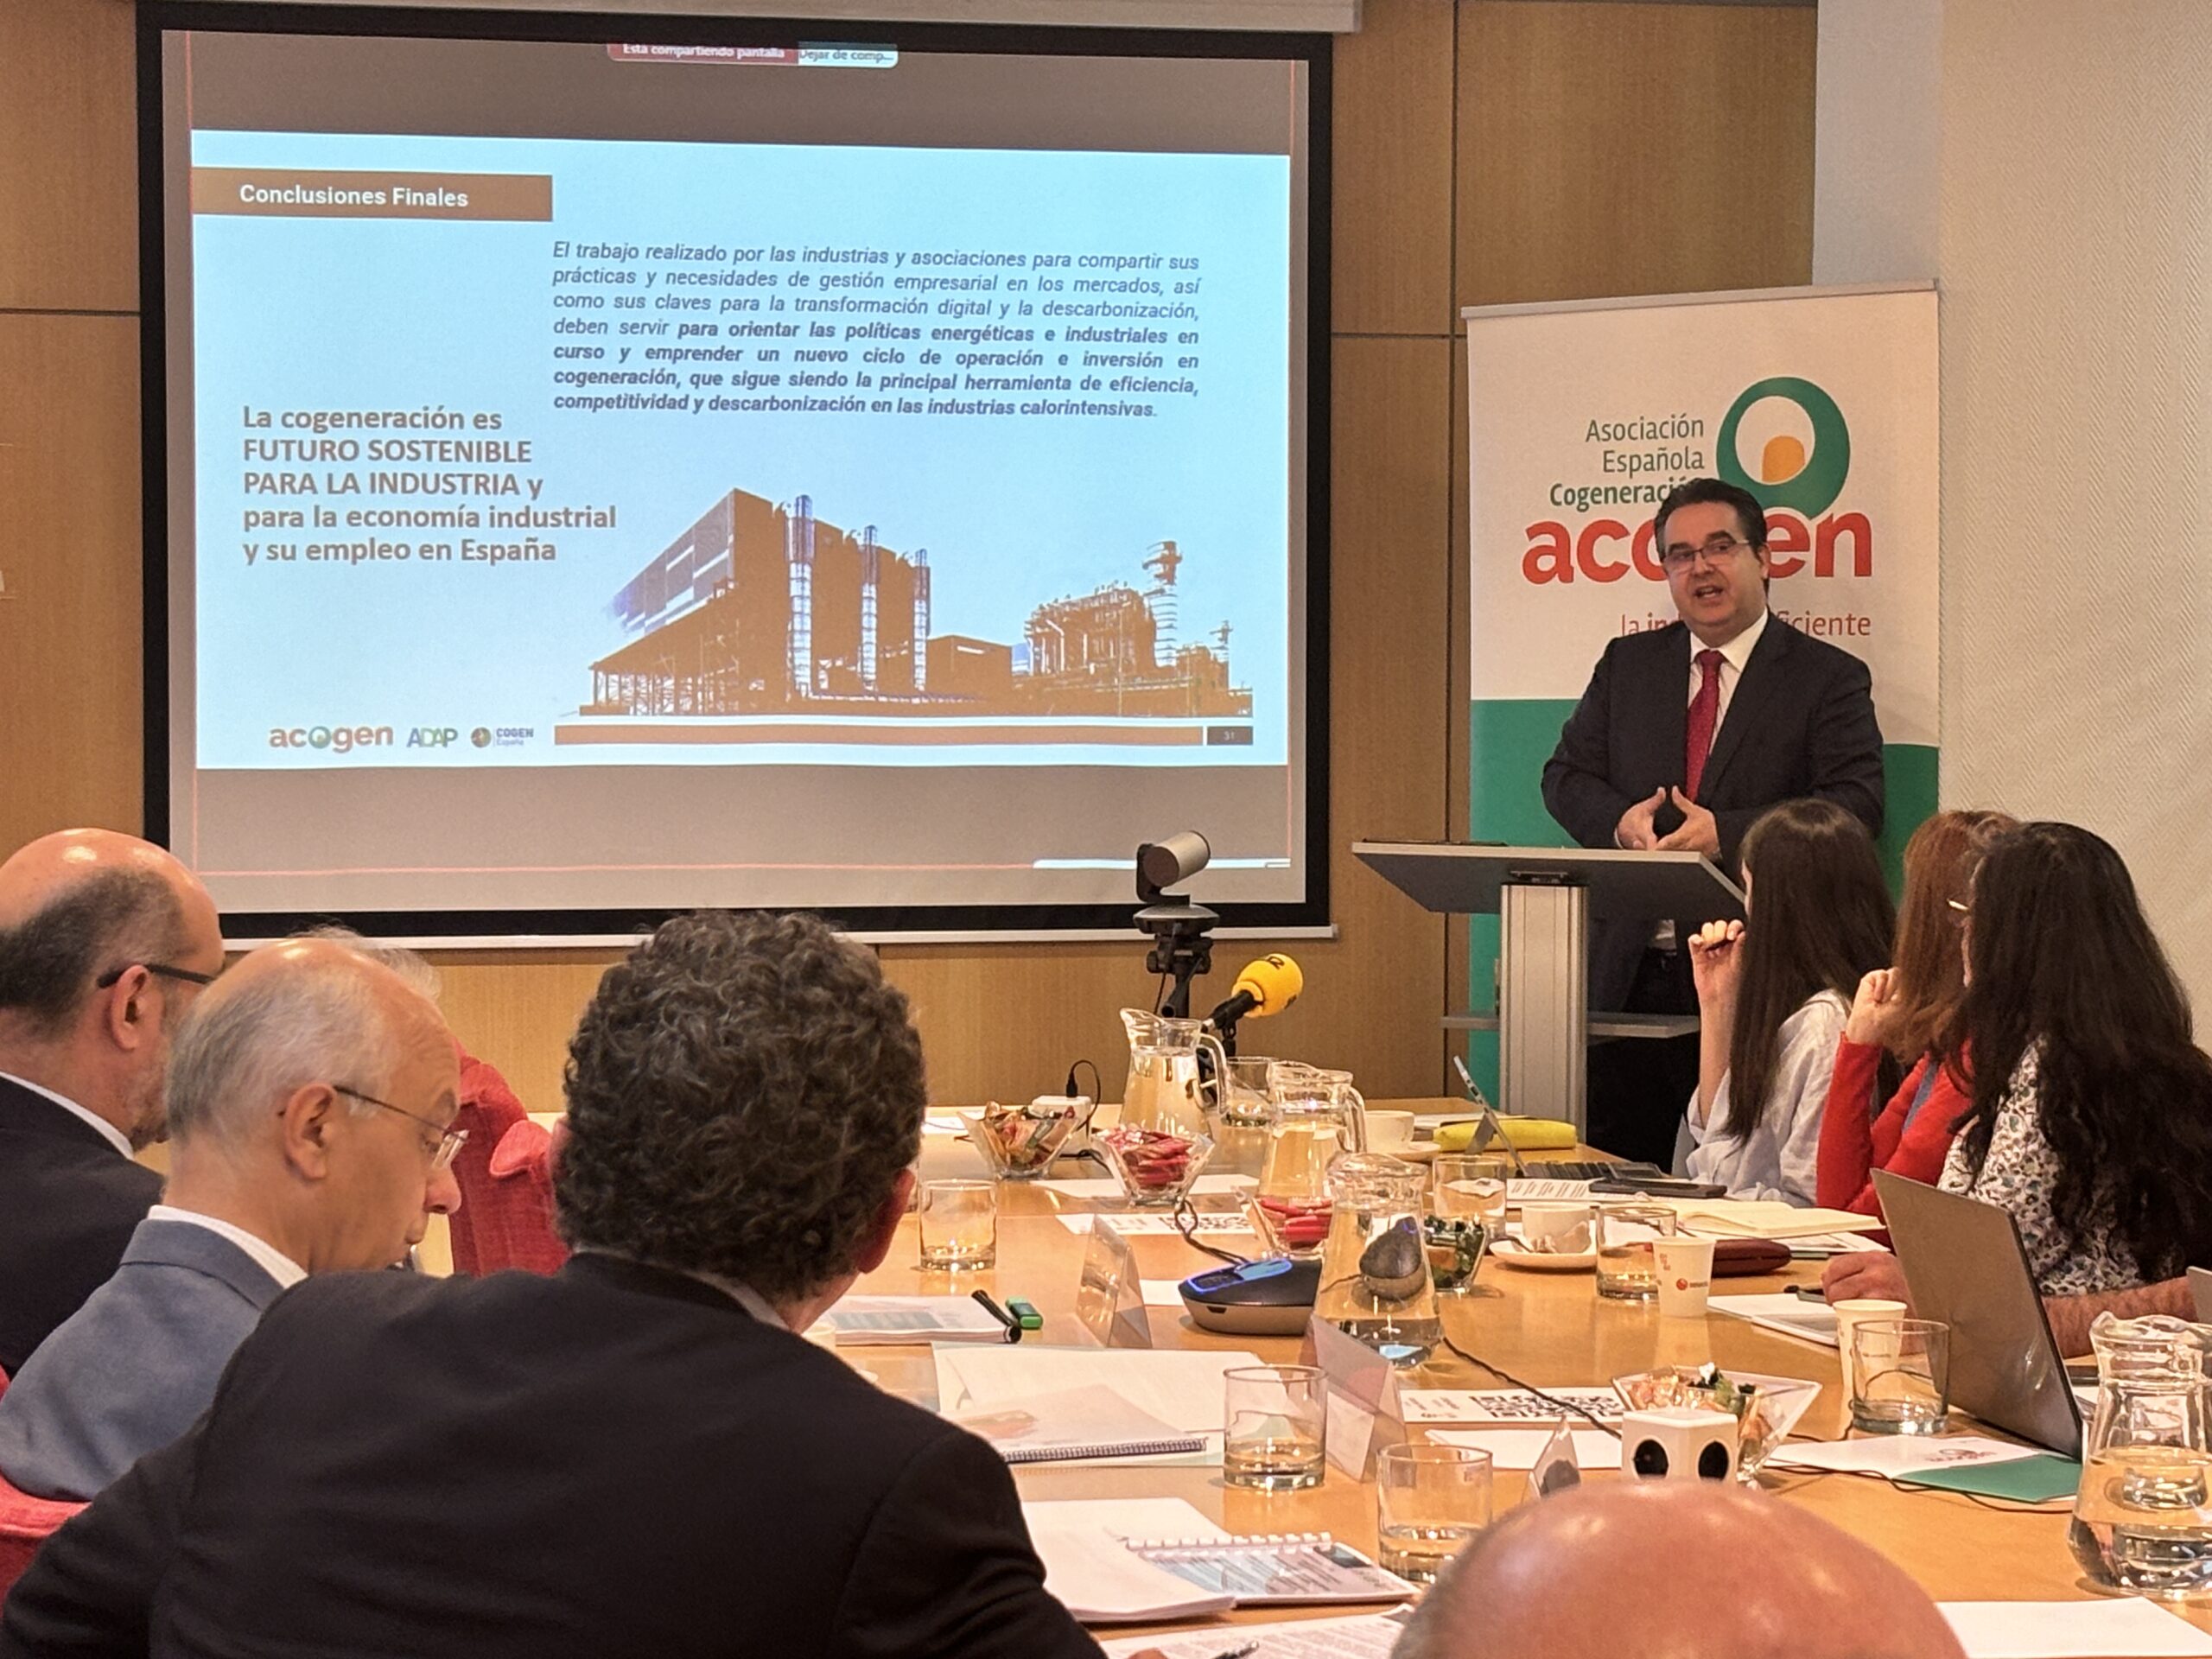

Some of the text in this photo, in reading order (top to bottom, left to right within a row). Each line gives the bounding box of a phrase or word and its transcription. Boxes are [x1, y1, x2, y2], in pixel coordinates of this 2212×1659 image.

[832, 50, 848, 60] de
[240, 185, 468, 207] Conclusiones Finales
[553, 241, 1199, 272] El trabajo realizado por las industrias y asociaciones para compartir sus
[552, 266, 1202, 296] prácticas y necesidades de gestión empresarial en los mercados, así
[553, 293, 1198, 321] como sus claves para la transformación digital y la descarbonización,
[554, 317, 1198, 345] deben servir para orientar las políticas energéticas e industriales en
[554, 345, 1198, 369] curso y emprender un nuevo ciclo de operación e inversión en
[554, 367, 1198, 397] cogeneración, que sigue siendo la principal herramienta de eficiencia,
[554, 393, 1157, 416] competitividad y descarbonización en las industrias calorintensivas.
[244, 404, 502, 434] La cogeneración es
[1586, 413, 1704, 442] Asociación
[245, 439, 532, 463] FUTURO SOSTENIBLE
[1603, 446, 1705, 480] Española
[245, 472, 543, 500] PARA LA INDUSTRIA y
[245, 504, 615, 532] para la economía industrial
[243, 537, 556, 566] y su empleo en España
[269, 726, 394, 753] acogen
[496, 728, 534, 738] COGEN
